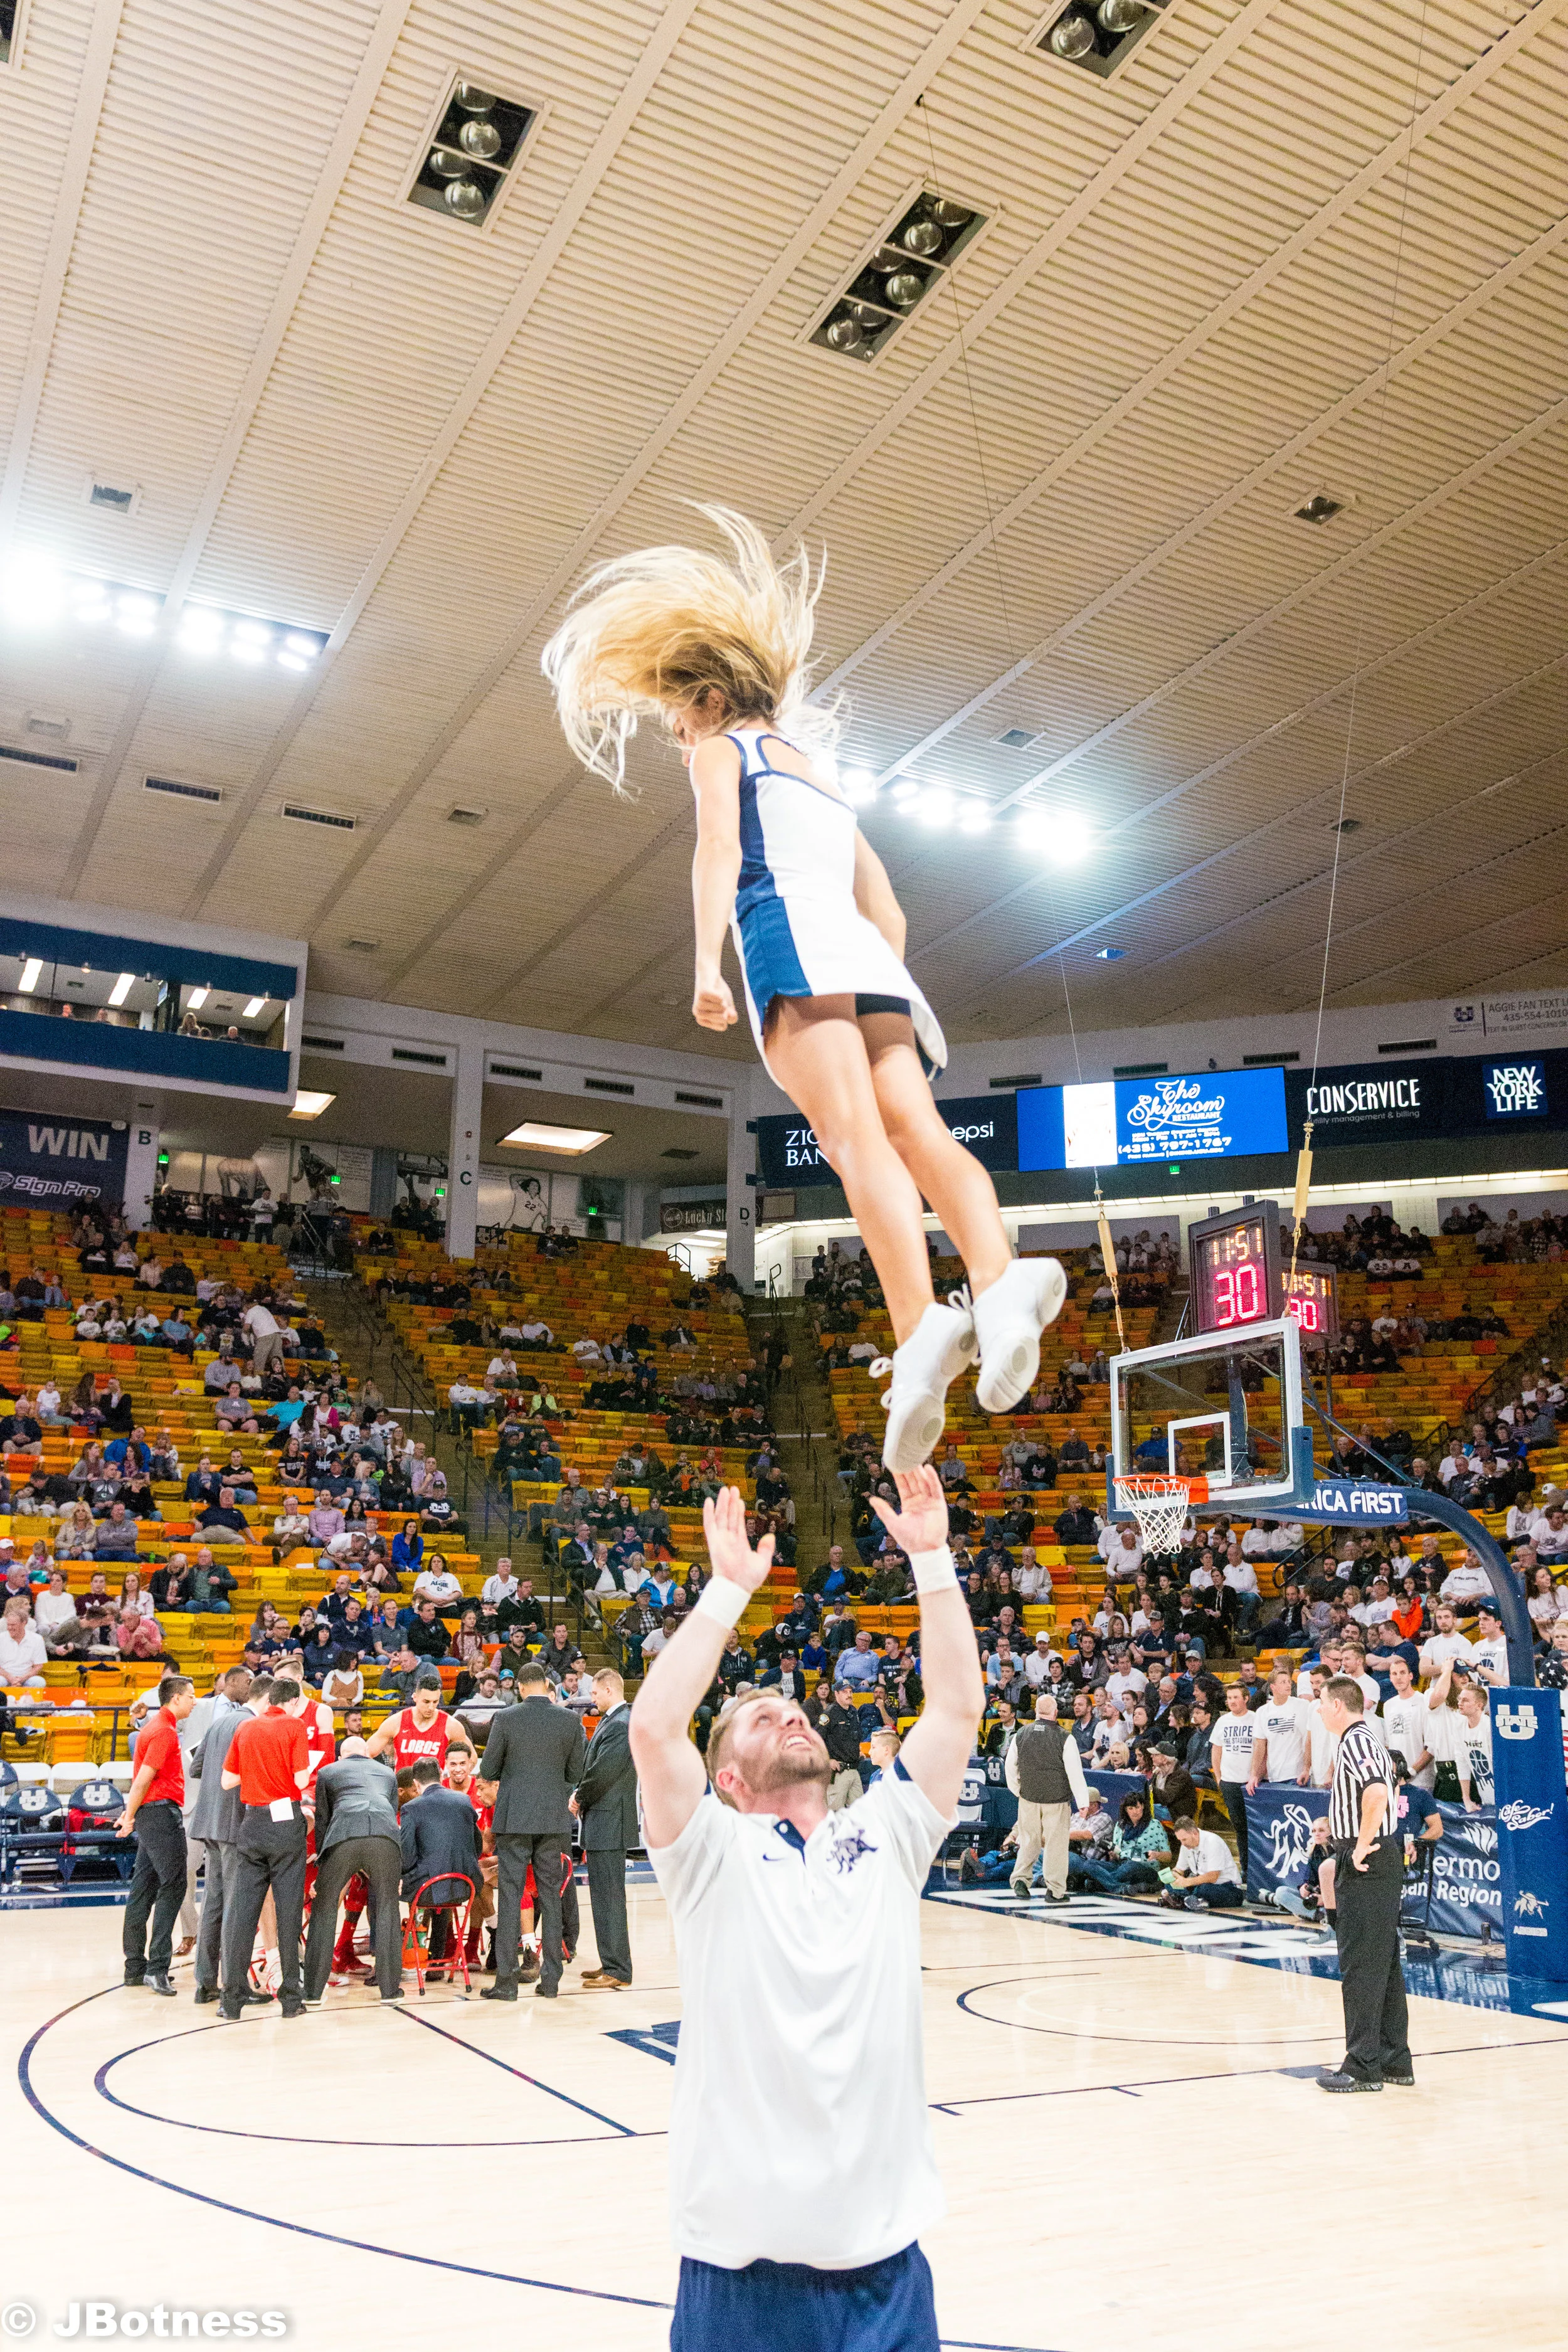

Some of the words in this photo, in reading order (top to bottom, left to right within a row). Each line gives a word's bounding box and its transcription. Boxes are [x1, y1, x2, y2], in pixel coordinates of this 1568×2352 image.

[1488, 1003, 1517, 1012] AGGIE
[1518, 1000, 1537, 1009] FAN
[1538, 998, 1560, 1007] TEXT
[1492, 1066, 1536, 1085] NEW
[1155, 1079, 1200, 1106] The
[1486, 1079, 1544, 1099] YORK
[1127, 1094, 1225, 1131] Skyroom
[1496, 1095, 1539, 1112] LIFE
[1171, 1111, 1222, 1122] RESTAURANT
[1331, 1113, 1385, 1123] management
[1387, 1111, 1394, 1119] &
[1396, 1110, 1420, 1119] billing
[28, 1125, 109, 1160] WIN
[138, 1131, 151, 1145] B
[13, 1175, 62, 1196] Sign
[460, 1171, 472, 1185] C
[524, 1200, 537, 1211] 22
[739, 1207, 750, 1220] D
[684, 1209, 712, 1224] Lucky
[1213, 1227, 1262, 1266] 11:51
[1216, 1263, 1259, 1327] 30
[1290, 1298, 1317, 1330] 30
[1350, 1490, 1403, 1515] FIRST
[1495, 1714, 1539, 1729] STATE
[1496, 1704, 1535, 1740] U
[1224, 1725, 1253, 1737] STRIPE
[400, 1739, 441, 1756] LOBOS
[1433, 1855, 1501, 1881] ermo
